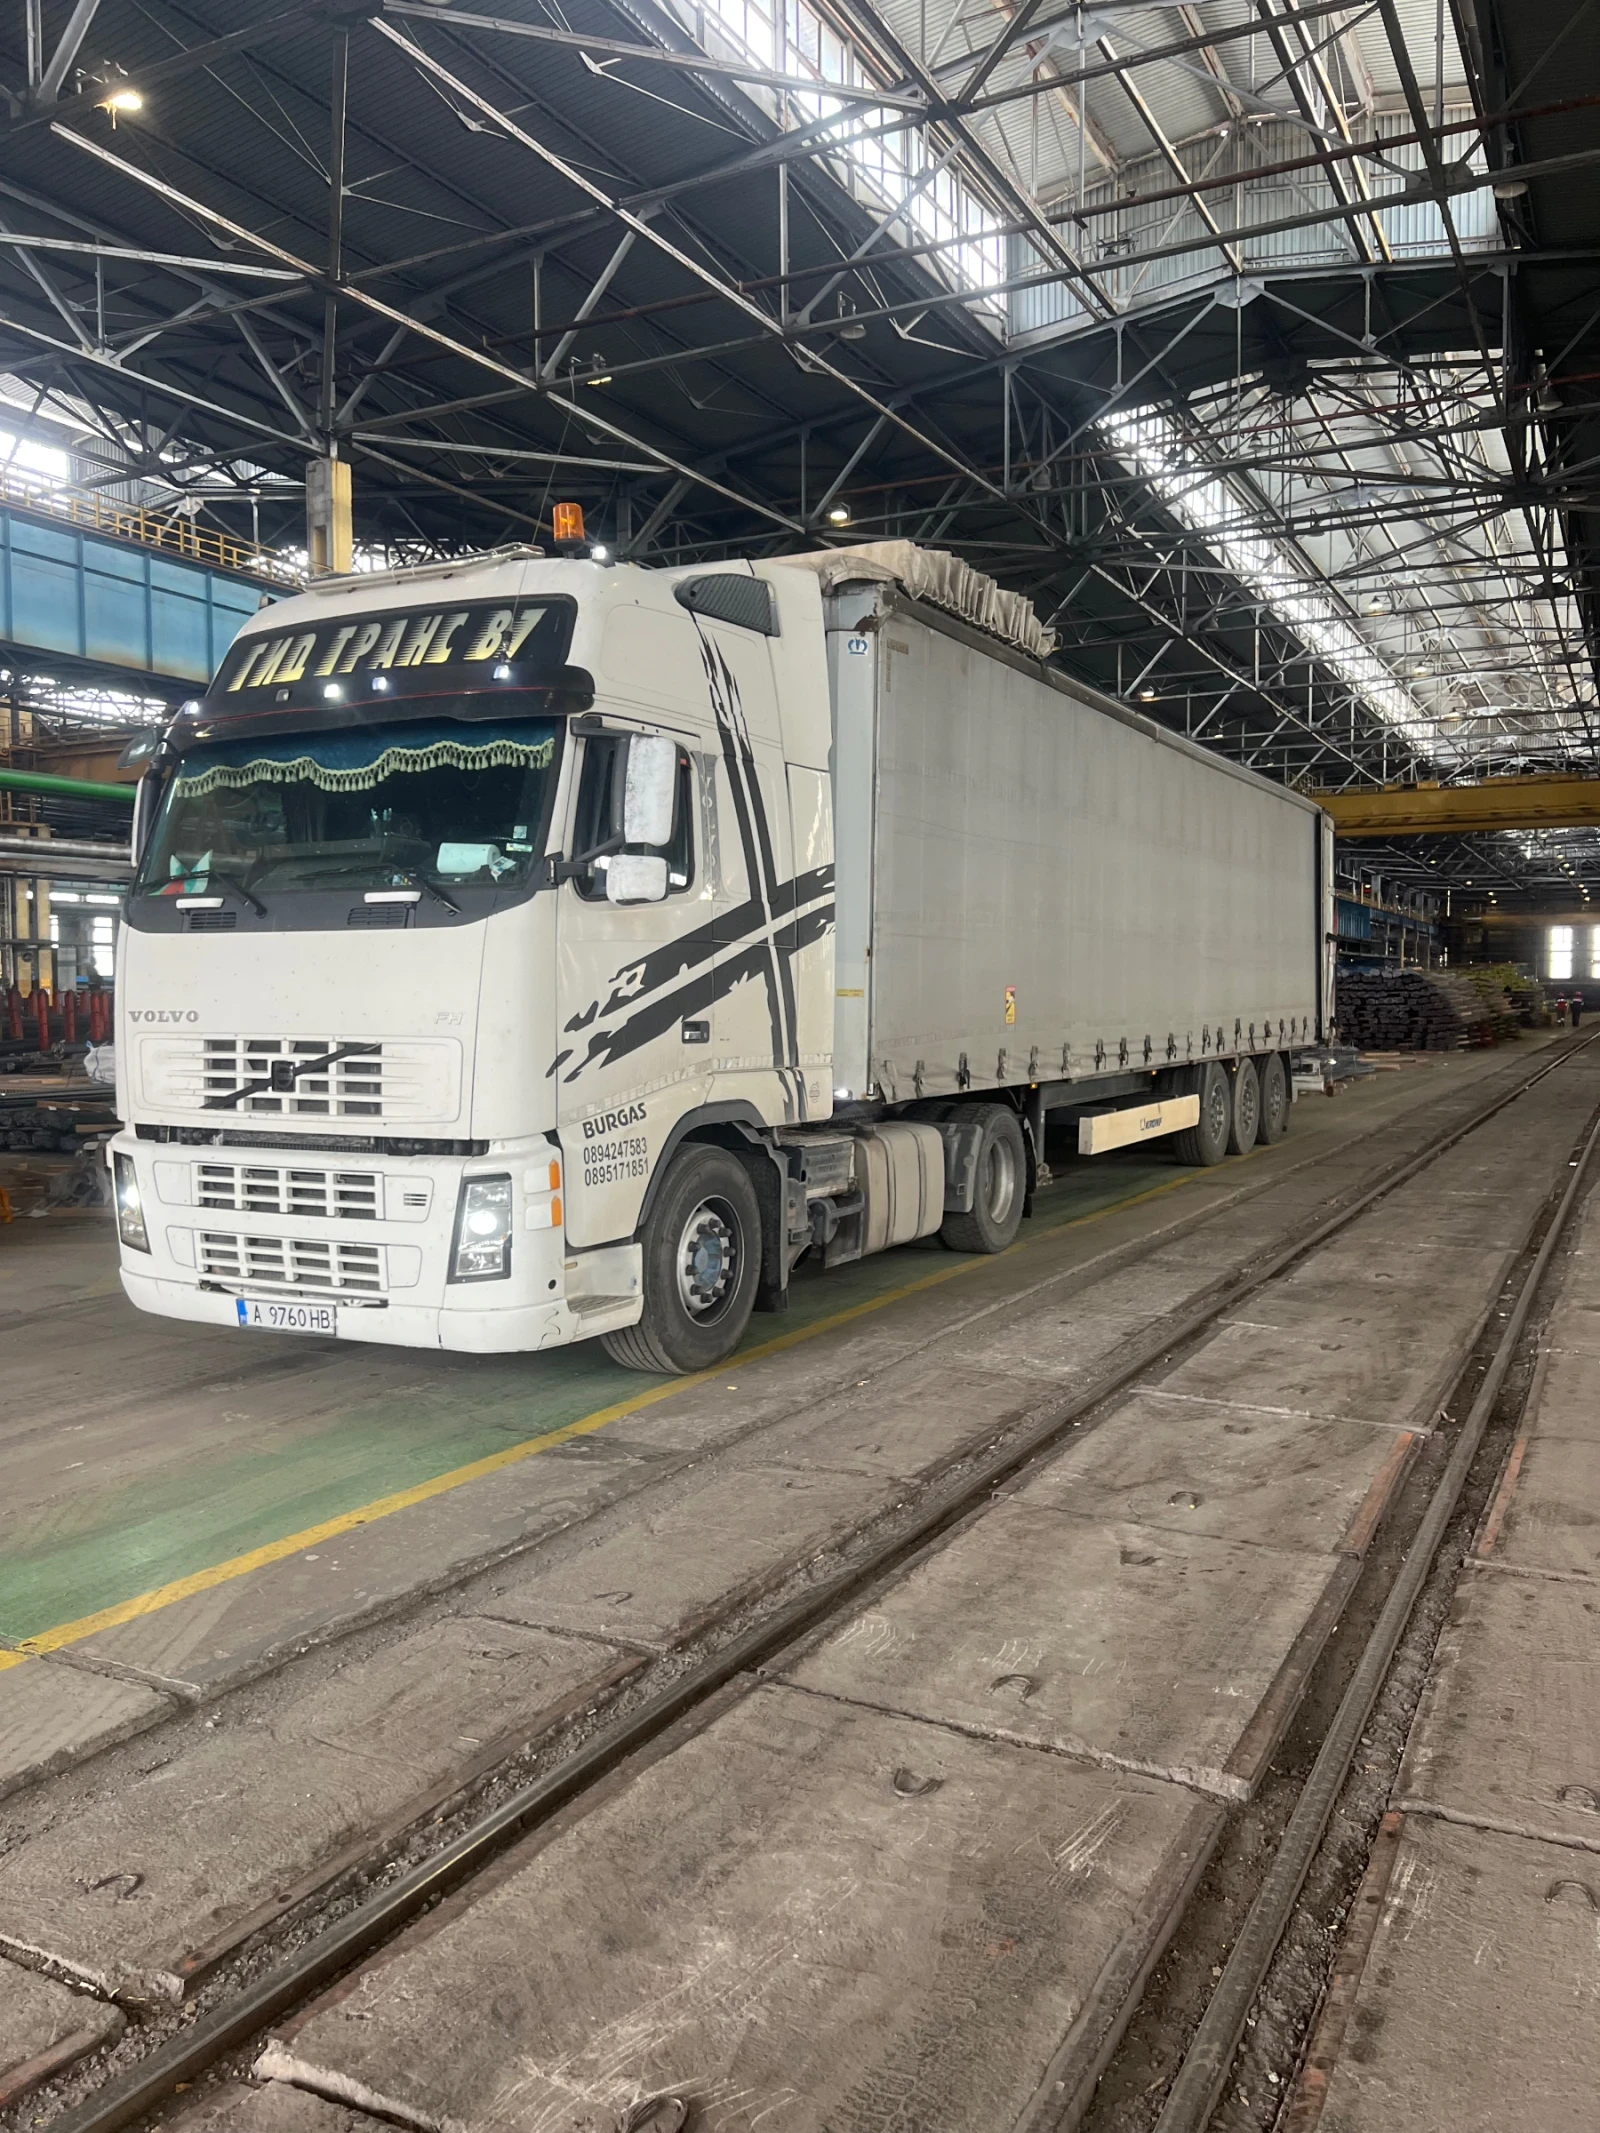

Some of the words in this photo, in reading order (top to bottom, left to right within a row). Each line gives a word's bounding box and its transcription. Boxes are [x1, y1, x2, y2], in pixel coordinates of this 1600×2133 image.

[313, 613, 470, 676] ТРАНС
[128, 1010, 199, 1022] VOLVO
[434, 1011, 464, 1025] FH
[582, 1102, 647, 1139] BURGAS
[583, 1137, 647, 1165] 0894247583
[584, 1157, 649, 1186] 0895171851
